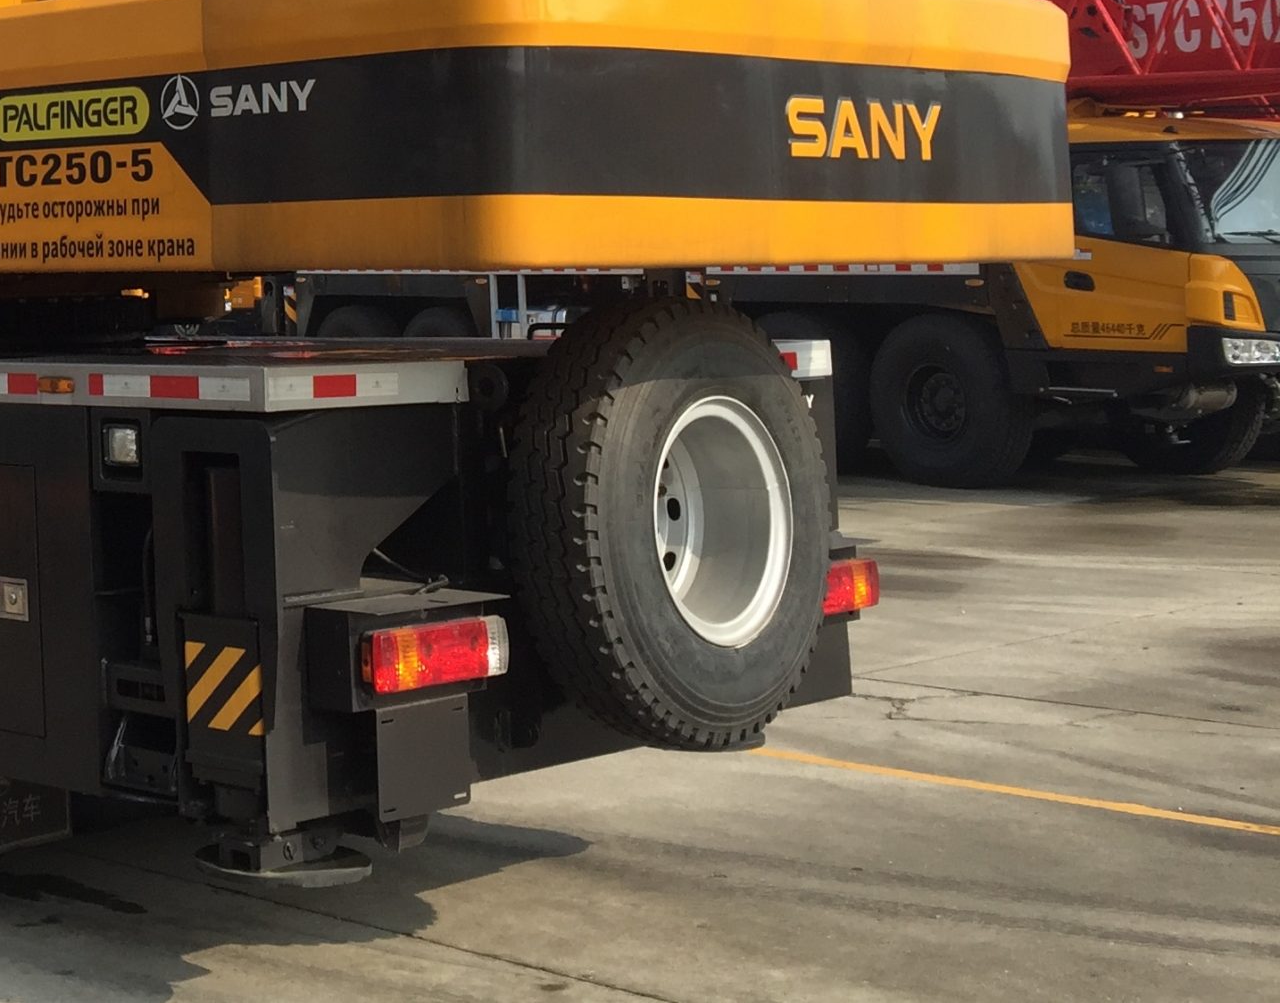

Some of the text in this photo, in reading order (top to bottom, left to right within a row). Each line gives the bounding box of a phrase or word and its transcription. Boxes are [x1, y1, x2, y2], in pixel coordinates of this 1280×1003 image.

[3, 95, 137, 133] PALFINGER
[209, 79, 316, 117] SANY
[785, 94, 942, 162] SANY
[42, 198, 127, 223] осторожны
[131, 197, 160, 221] при
[30, 243, 38, 259] в
[42, 233, 104, 263] рабочей
[107, 239, 143, 258] зоне
[147, 236, 195, 262] крана
